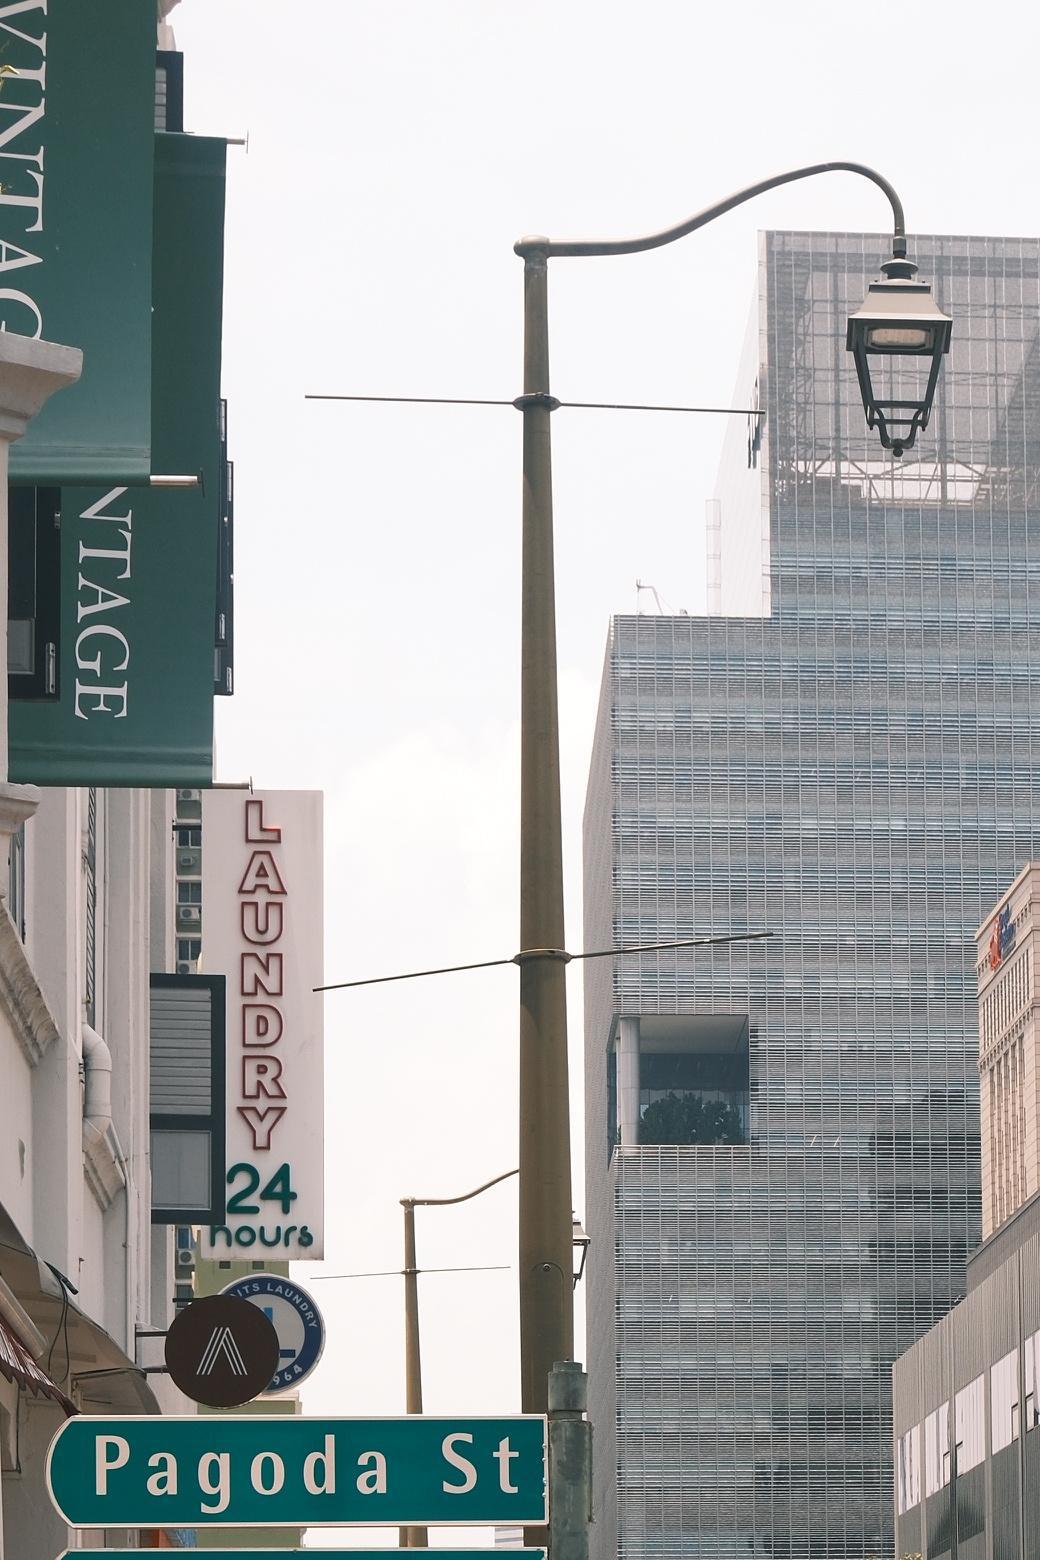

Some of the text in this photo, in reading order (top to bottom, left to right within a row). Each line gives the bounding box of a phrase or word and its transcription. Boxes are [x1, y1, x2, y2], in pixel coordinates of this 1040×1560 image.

[239, 800, 287, 1151] LAUNDRY
[226, 1162, 298, 1215] 24
[209, 1224, 314, 1248] hours
[229, 1282, 319, 1328] ITS LAUNDRY
[94, 1432, 520, 1514] Pagoda St
